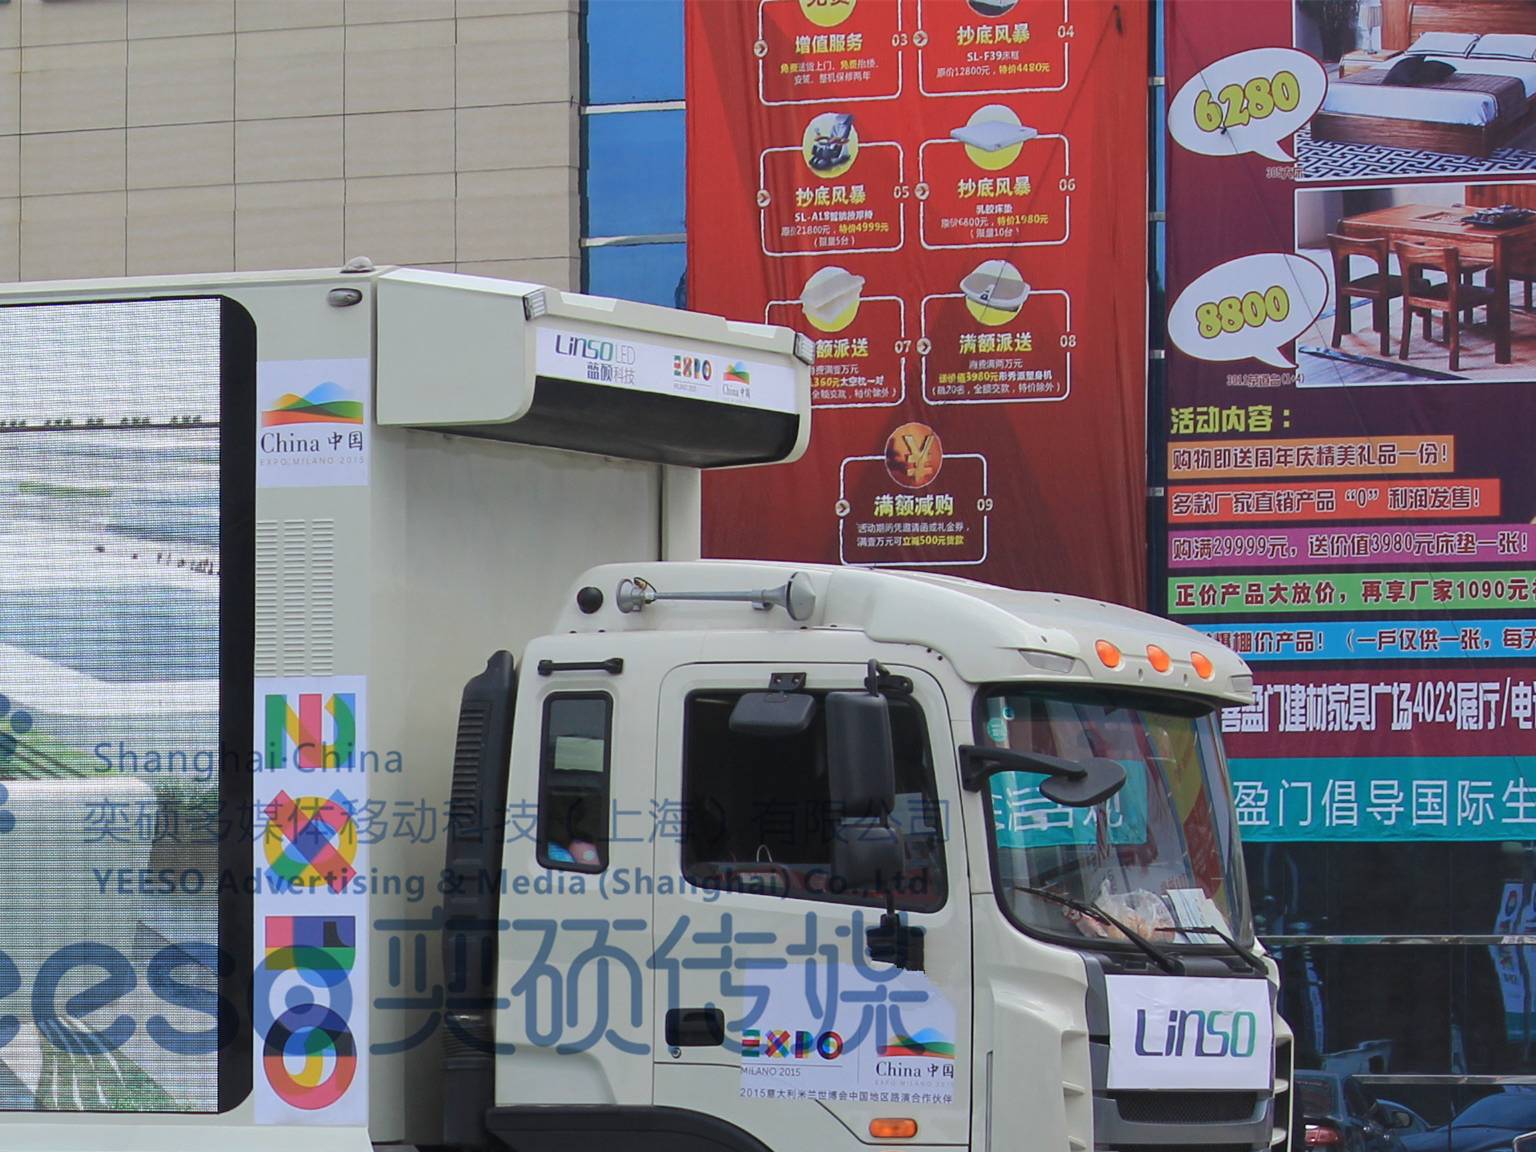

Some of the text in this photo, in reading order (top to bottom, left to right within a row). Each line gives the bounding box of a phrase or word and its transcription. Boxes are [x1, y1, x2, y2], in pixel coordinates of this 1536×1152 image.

[892, 33, 908, 47] 03
[957, 23, 1031, 46] 抄底风暴
[1057, 25, 1075, 38] 04
[795, 33, 863, 54] 增值服务
[1193, 71, 1300, 132] 6280
[796, 184, 866, 207] 抄底风暴
[894, 186, 910, 199] 05
[957, 176, 1032, 199] 抄底风暴
[1059, 178, 1076, 191] 06
[1196, 286, 1290, 339] 8800
[894, 340, 911, 353] 07
[959, 332, 1033, 354] 满额派送
[1060, 335, 1077, 348] 08
[673, 354, 712, 382] EXPO
[260, 430, 364, 453] China 中国
[874, 493, 953, 517] 满额减购
[977, 498, 993, 511] 09
[1175, 578, 1536, 607] 正价产品大放价，再享厂家1090元
[740, 1029, 844, 1060] EXPO
[740, 1066, 801, 1077] MILANO 2015
[875, 1061, 955, 1079] China 中国
